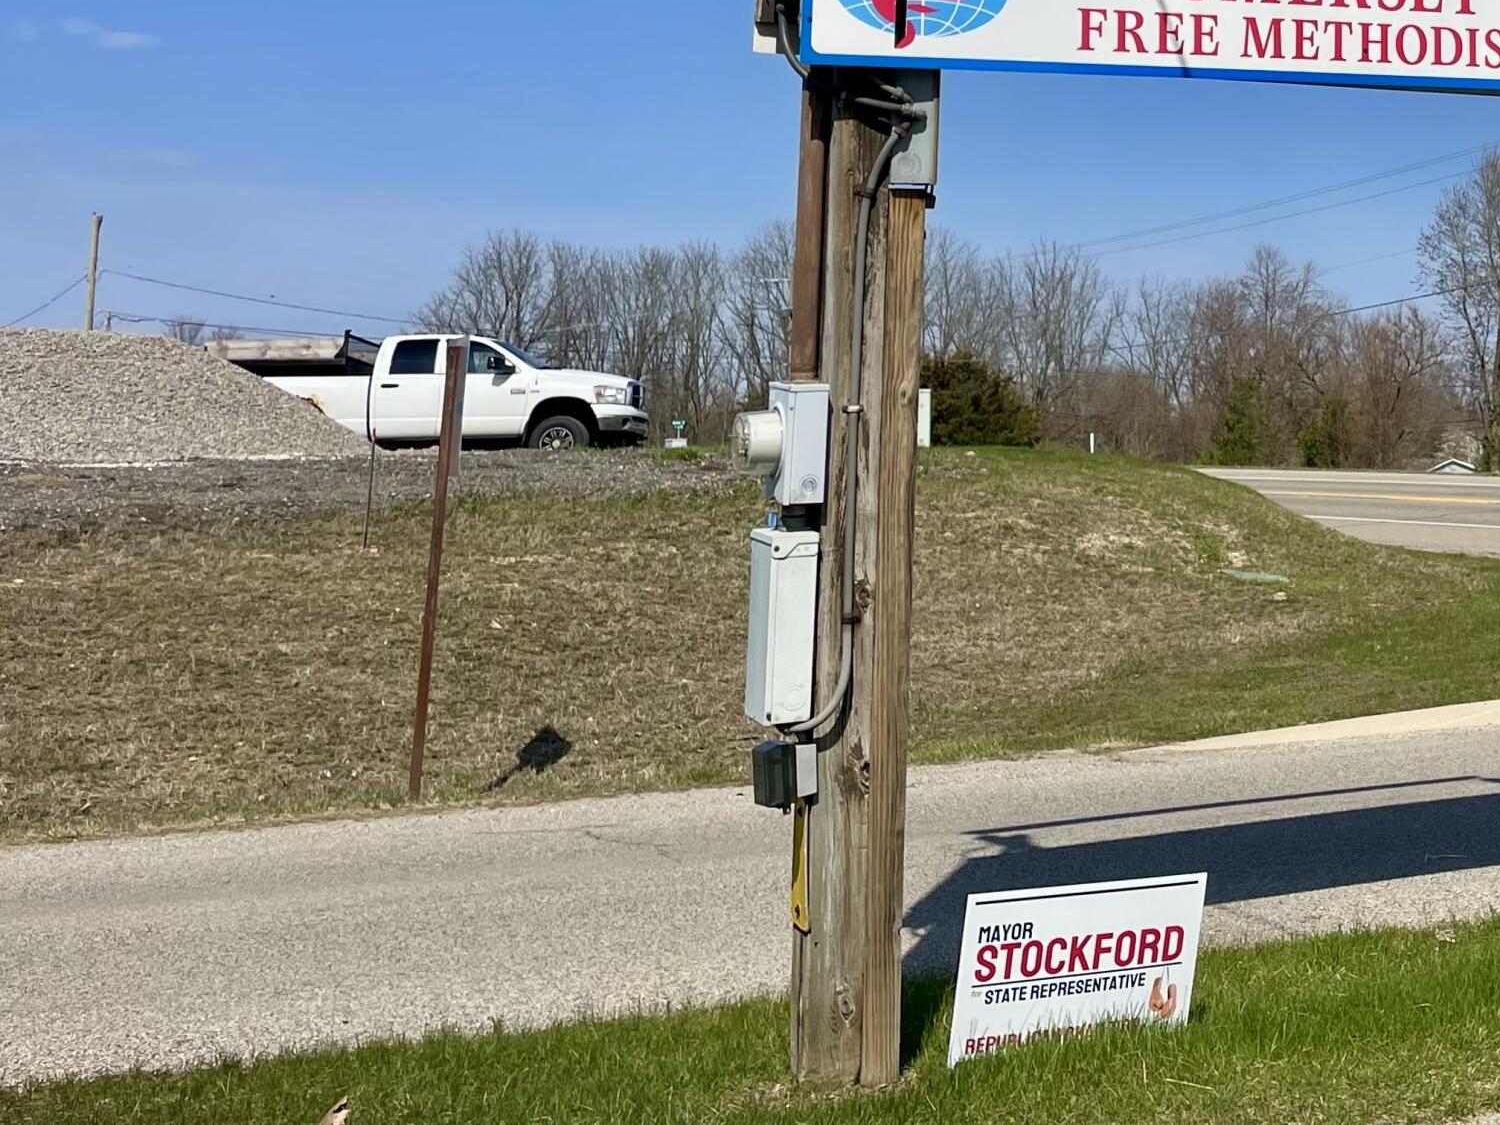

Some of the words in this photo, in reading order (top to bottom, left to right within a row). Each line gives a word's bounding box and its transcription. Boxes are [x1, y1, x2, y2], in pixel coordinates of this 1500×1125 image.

[1077, 7, 1220, 56] FREE
[978, 922, 1034, 944] MAYOR
[974, 925, 1184, 983] STOCKFORD
[984, 985, 1027, 1005] STATE
[1030, 972, 1146, 1000] REPRESENTATIVE
